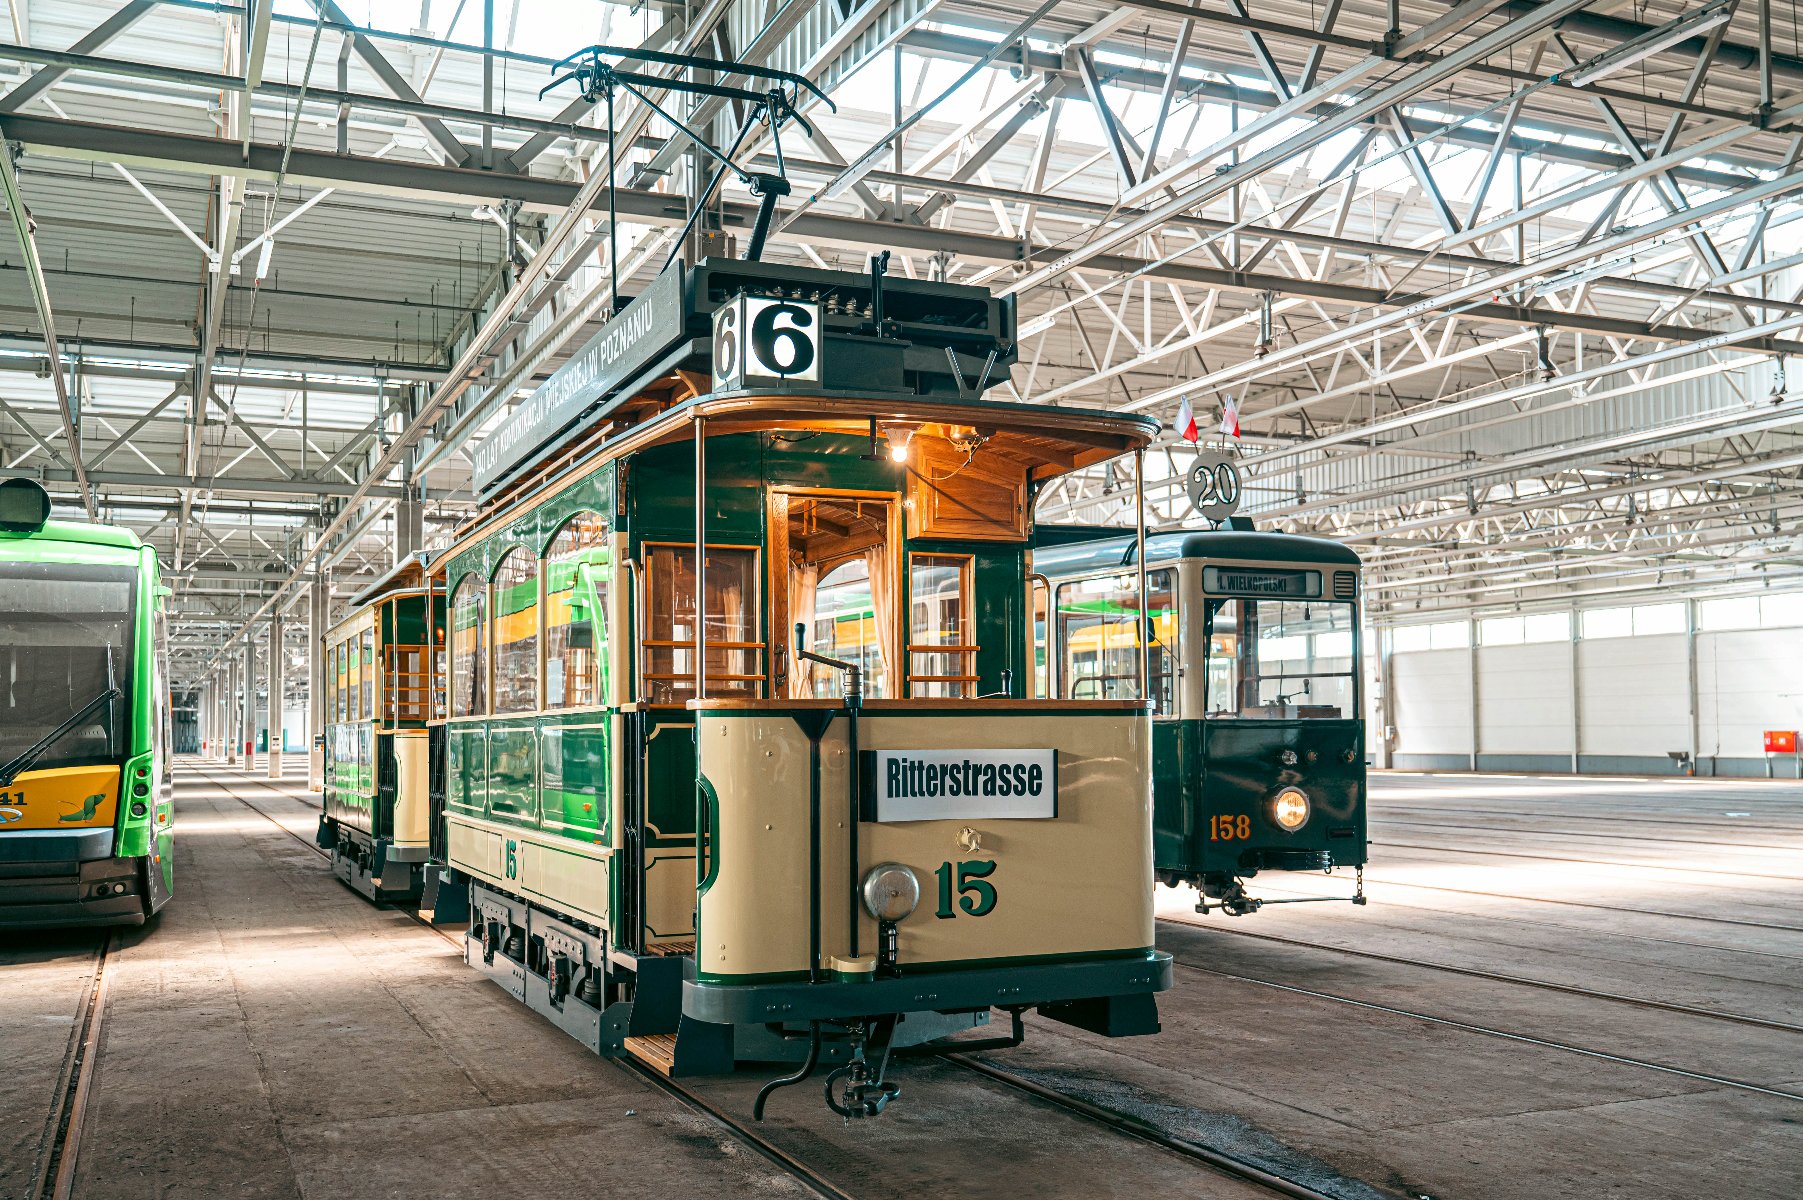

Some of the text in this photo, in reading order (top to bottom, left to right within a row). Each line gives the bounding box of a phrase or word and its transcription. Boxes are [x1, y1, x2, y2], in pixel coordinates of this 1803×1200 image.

[715, 307, 737, 380] 6
[752, 303, 815, 375] 6
[487, 436, 498, 470] LAT
[501, 396, 544, 455] KOMUNIKACJI
[545, 353, 588, 416] MIEJSKIEJ
[589, 345, 599, 376] W
[600, 297, 653, 370] POZNANIU
[1193, 463, 1238, 509] 20
[1227, 574, 1287, 593] WIELKOPOLSKI
[886, 757, 1043, 799] Ritterstrasse
[1210, 814, 1252, 842] 158
[505, 838, 518, 880] 15
[934, 859, 998, 920] 15
